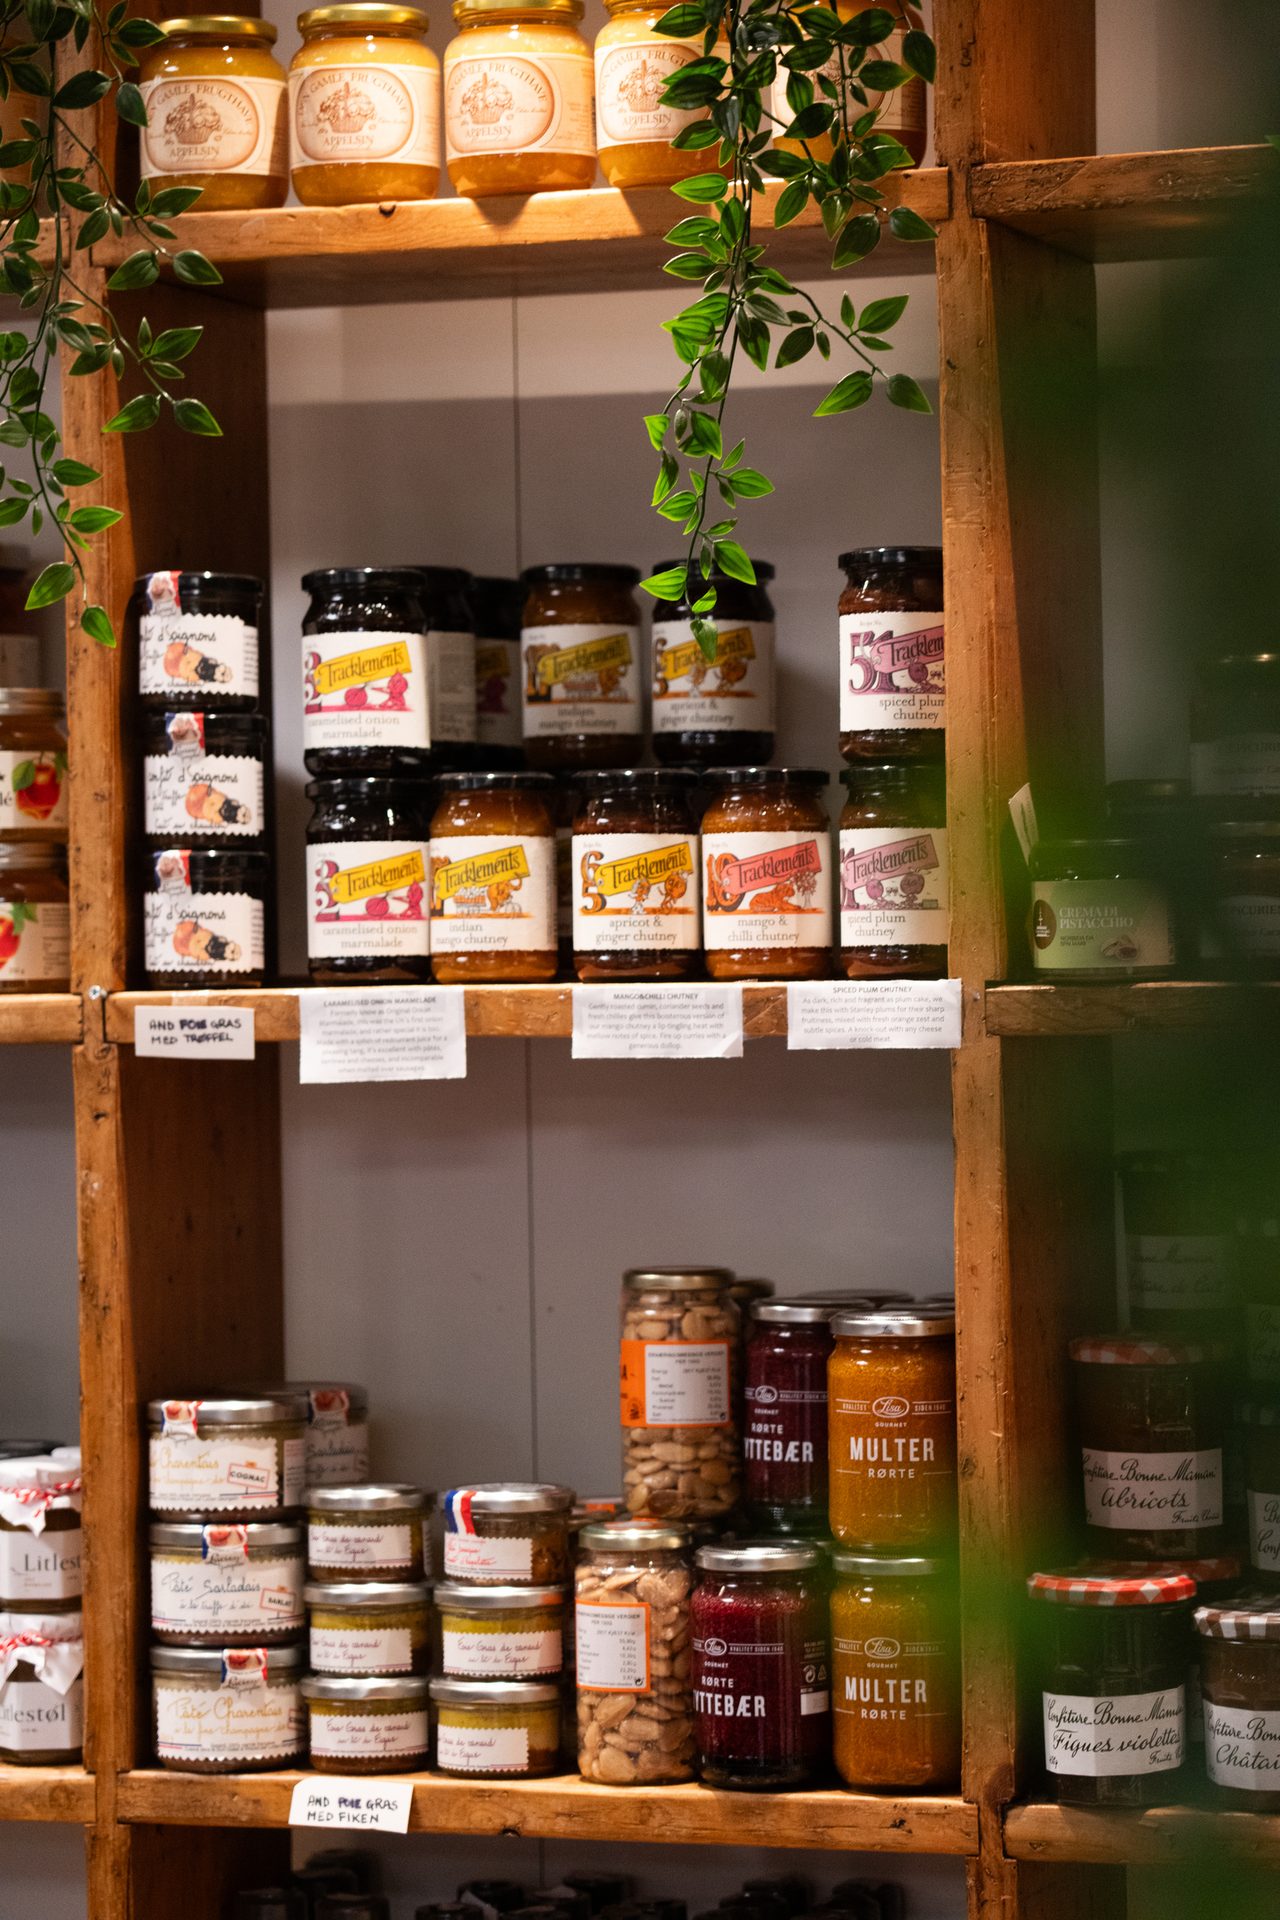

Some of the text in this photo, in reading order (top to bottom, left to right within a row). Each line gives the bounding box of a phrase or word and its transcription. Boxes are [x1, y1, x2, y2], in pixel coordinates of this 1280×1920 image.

[323, 135, 374, 147] APPELSIN
[169, 145, 220, 157] APPELSIN
[318, 645, 405, 688] Tracklements
[879, 695, 916, 710] spiced
[365, 715, 400, 725] onion
[893, 708, 940, 724] chutney
[322, 727, 383, 739] marmalade
[600, 846, 688, 889] Tracklements
[726, 845, 815, 889] Tracklements
[845, 840, 928, 884] Tracklements
[335, 855, 421, 897] Tracklements
[437, 849, 520, 893] Tracklements
[1104, 906, 1118, 916] DI
[449, 920, 483, 932] indian
[608, 914, 663, 931] apricot &
[737, 914, 788, 930] mango &
[875, 911, 907, 927] plum
[1060, 917, 1134, 929] PISTACCHIO
[386, 925, 418, 935] onion
[595, 930, 677, 945] ginger chutney
[727, 929, 800, 944] chilli chutney
[854, 925, 896, 940] chutney
[340, 937, 403, 949] marmalade
[464, 932, 508, 946] chutney
[925, 1006, 944, 1015] sharp
[149, 1019, 174, 1031] AND
[210, 1018, 242, 1030] GRAS
[151, 1035, 178, 1045] MED
[842, 1403, 933, 1412] KVALITET SIDEN
[877, 1398, 902, 1417] Lisa
[751, 1422, 784, 1435] RØRTE
[850, 1436, 935, 1462] MULTER
[229, 1470, 266, 1483] COGNAC
[867, 1468, 916, 1480] RØRTE
[1121, 1457, 1216, 1483] Bonne Maman
[1101, 1486, 1190, 1510] Abricots
[729, 1644, 771, 1653] KVALITET SIDEN
[704, 1661, 729, 1669] GOURMET
[701, 1675, 734, 1688] RØRTE
[845, 1675, 927, 1703] MULTER
[692, 1688, 766, 1718] YTTEBÆR
[860, 1708, 907, 1720] RØRTE
[1048, 1698, 1092, 1728] Confiture
[1093, 1700, 1144, 1726] Bonne
[1053, 1728, 1112, 1758] Figues
[307, 1795, 398, 1811] AND GRAS
[307, 1811, 379, 1824] MED FIKEN
